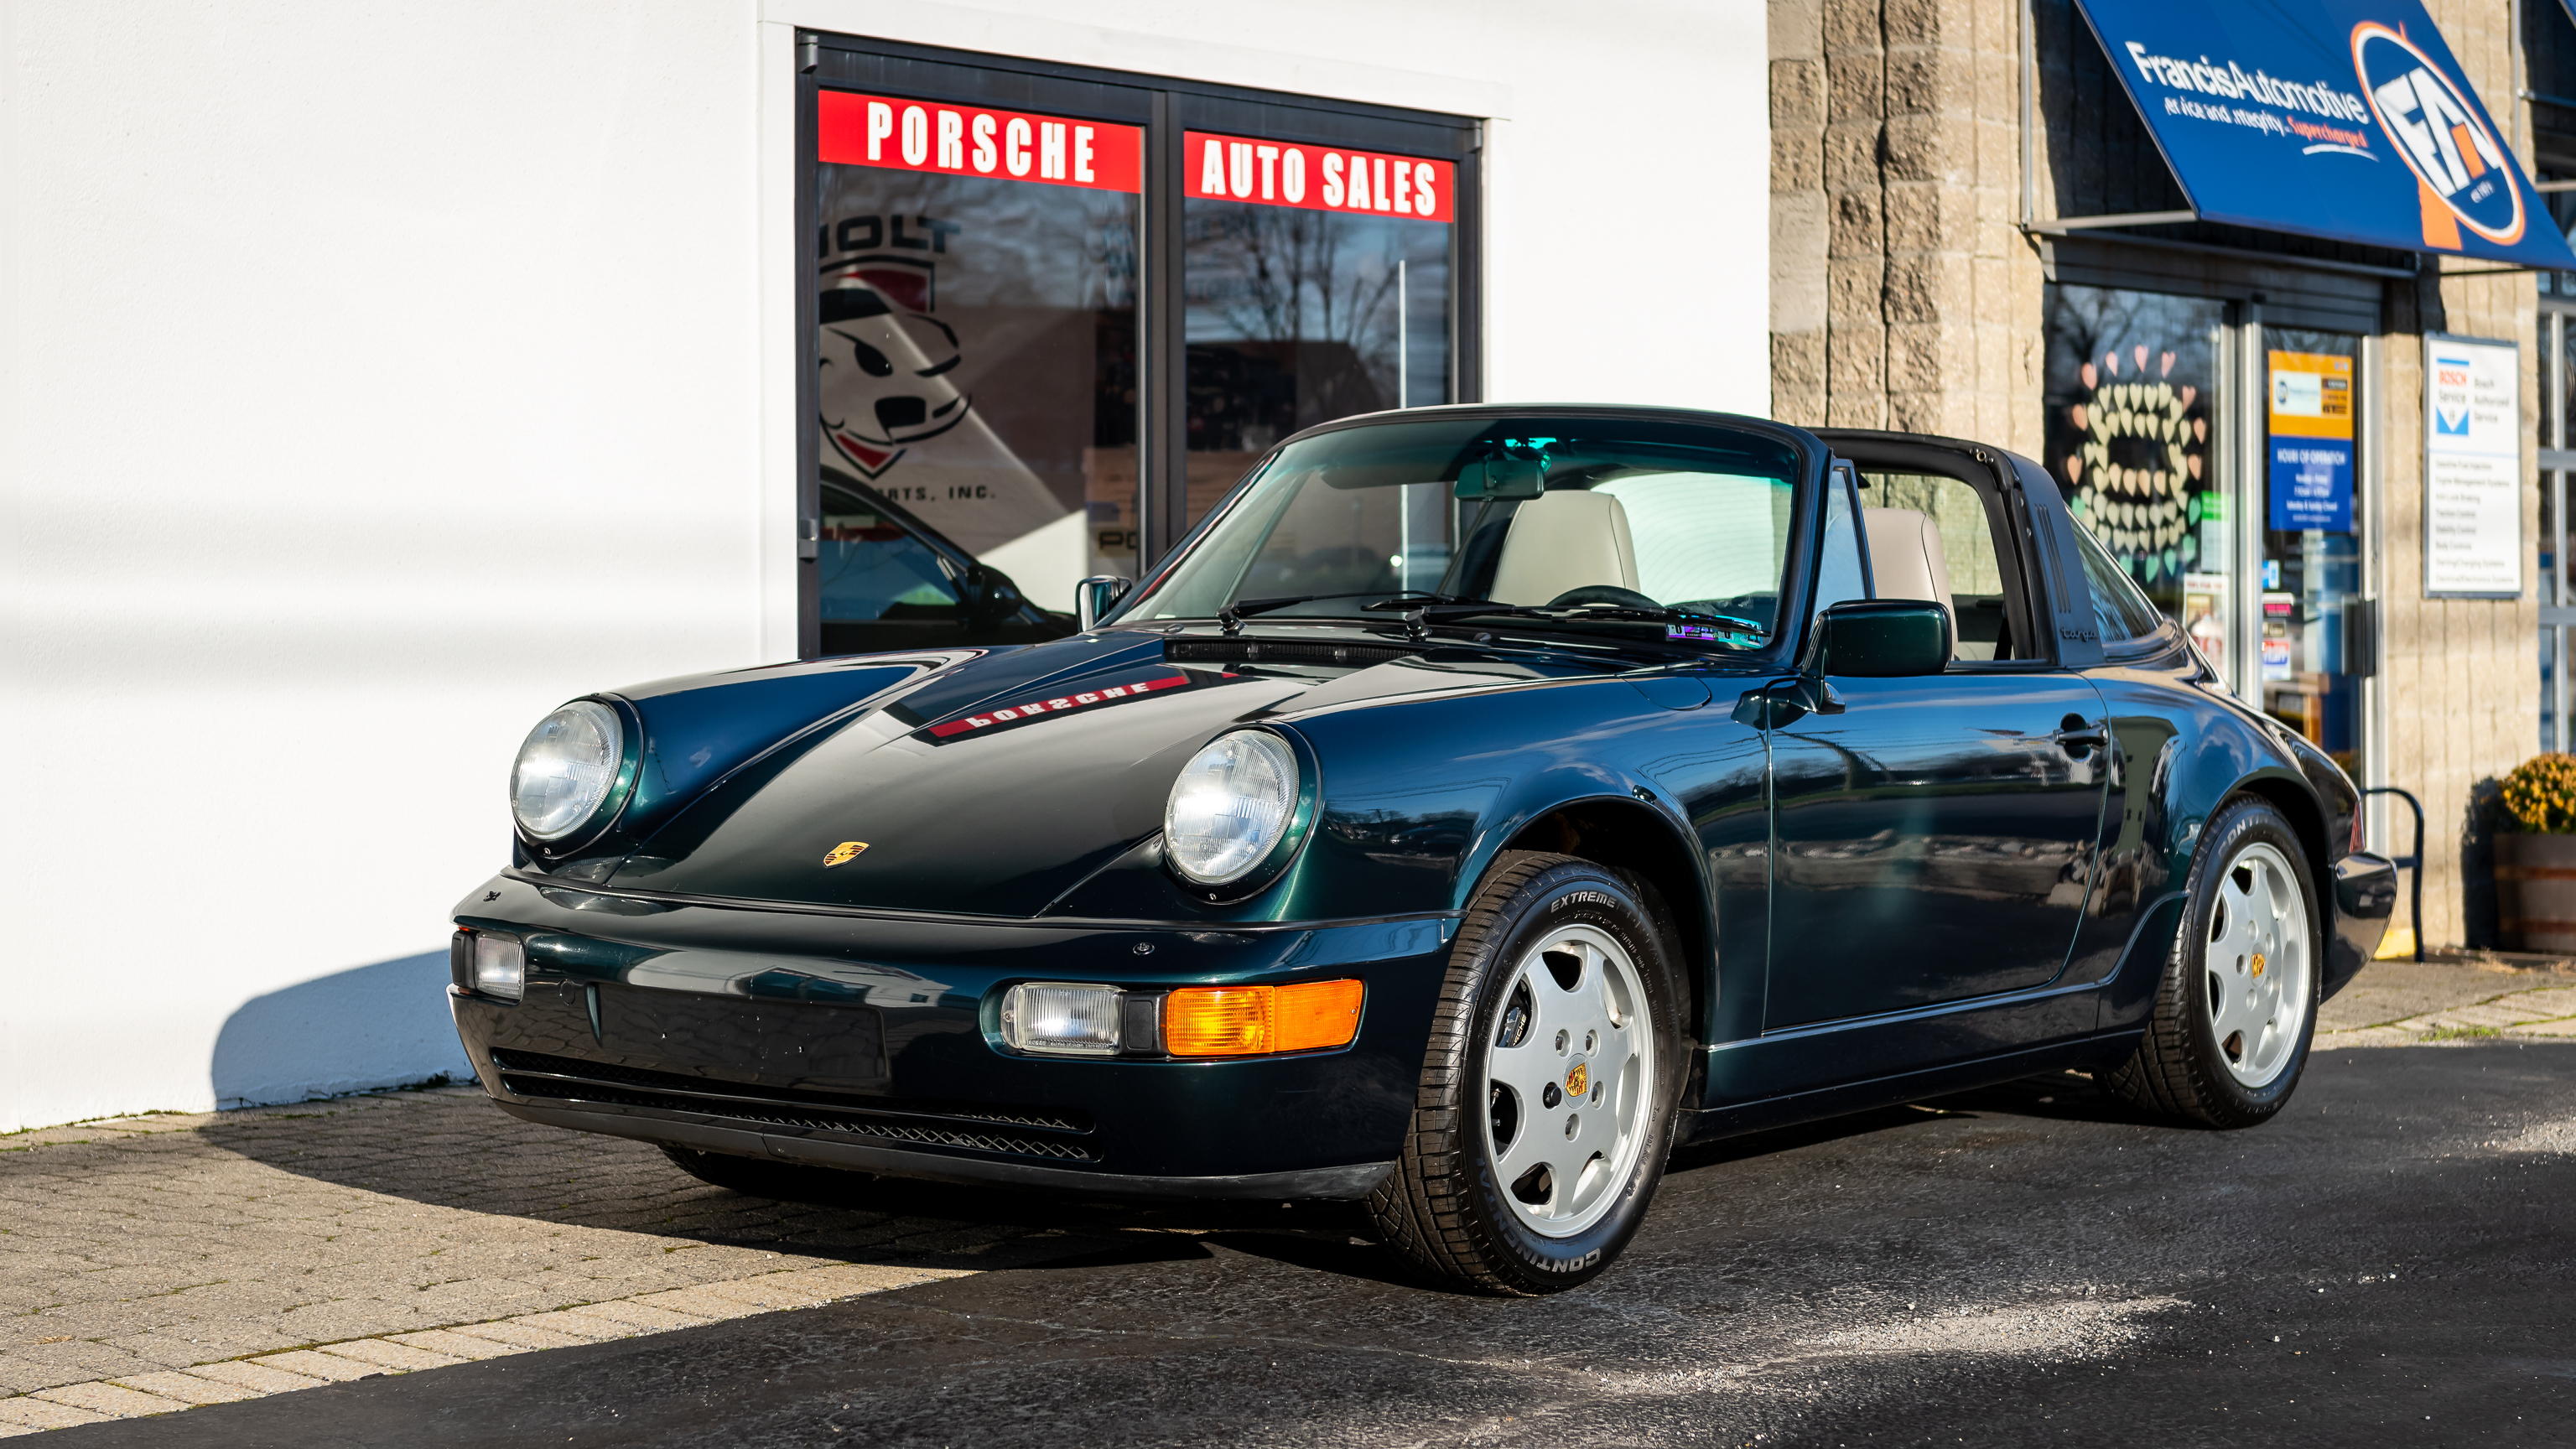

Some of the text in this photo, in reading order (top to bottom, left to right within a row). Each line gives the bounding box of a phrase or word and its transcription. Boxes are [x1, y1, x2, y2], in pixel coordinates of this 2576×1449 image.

[2287, 115, 2369, 148] Supercharged
[867, 101, 1095, 183] PORSCHE
[1201, 139, 1436, 216] AUTO SALES
[819, 214, 961, 259] OLT
[2438, 369, 2467, 387] BOSCH
[2474, 377, 2495, 389] Bosch
[2438, 388, 2466, 404] Service
[2474, 394, 2509, 408] Authorized
[2474, 409, 2498, 424] Service
[2277, 448, 2345, 465] HOURS OF OPERATION
[948, 486, 996, 499] INC.
[2059, 627, 2096, 642] targa
[1551, 891, 1617, 913] EXTREME
[1476, 1146, 1601, 1273] CONTINENTAL
